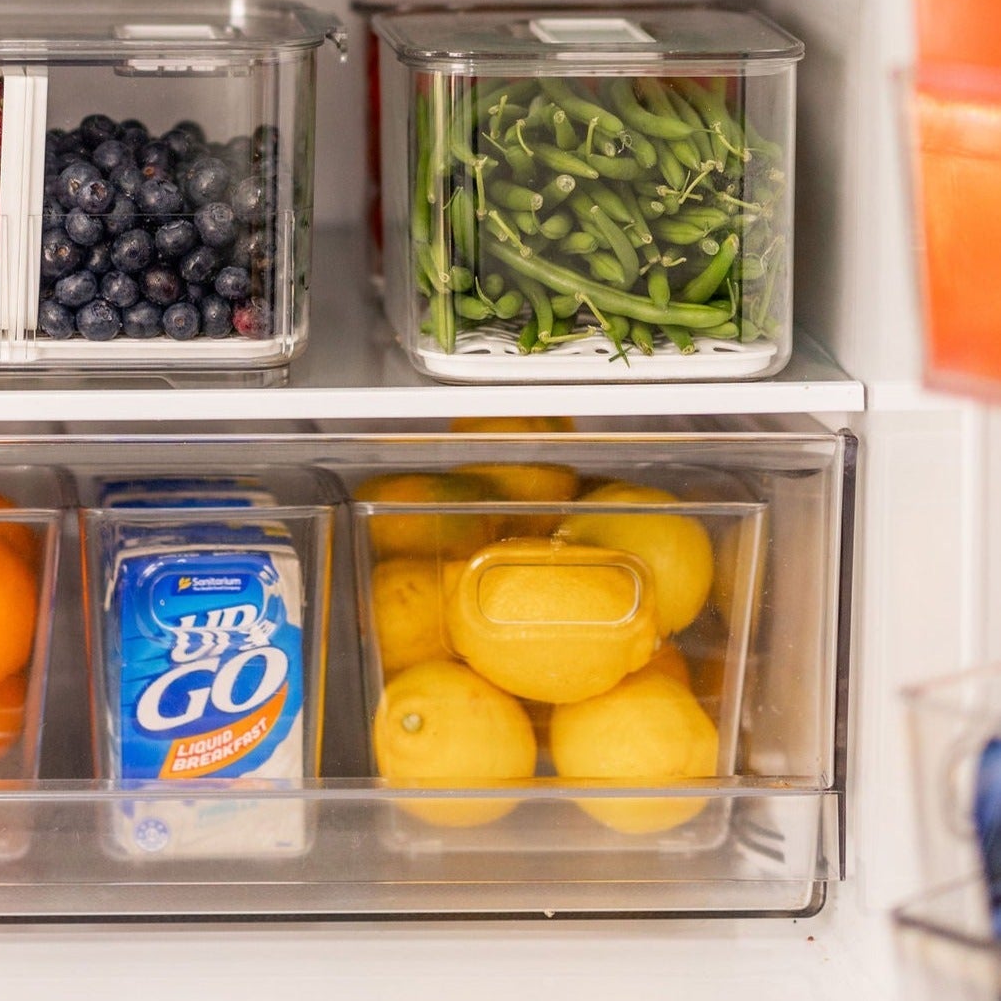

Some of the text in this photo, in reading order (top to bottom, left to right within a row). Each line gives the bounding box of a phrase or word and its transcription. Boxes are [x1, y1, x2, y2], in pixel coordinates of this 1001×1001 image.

[136, 646, 289, 731] GO
[171, 717, 269, 772] BREAKFAST
[176, 729, 233, 757] LIQUID
